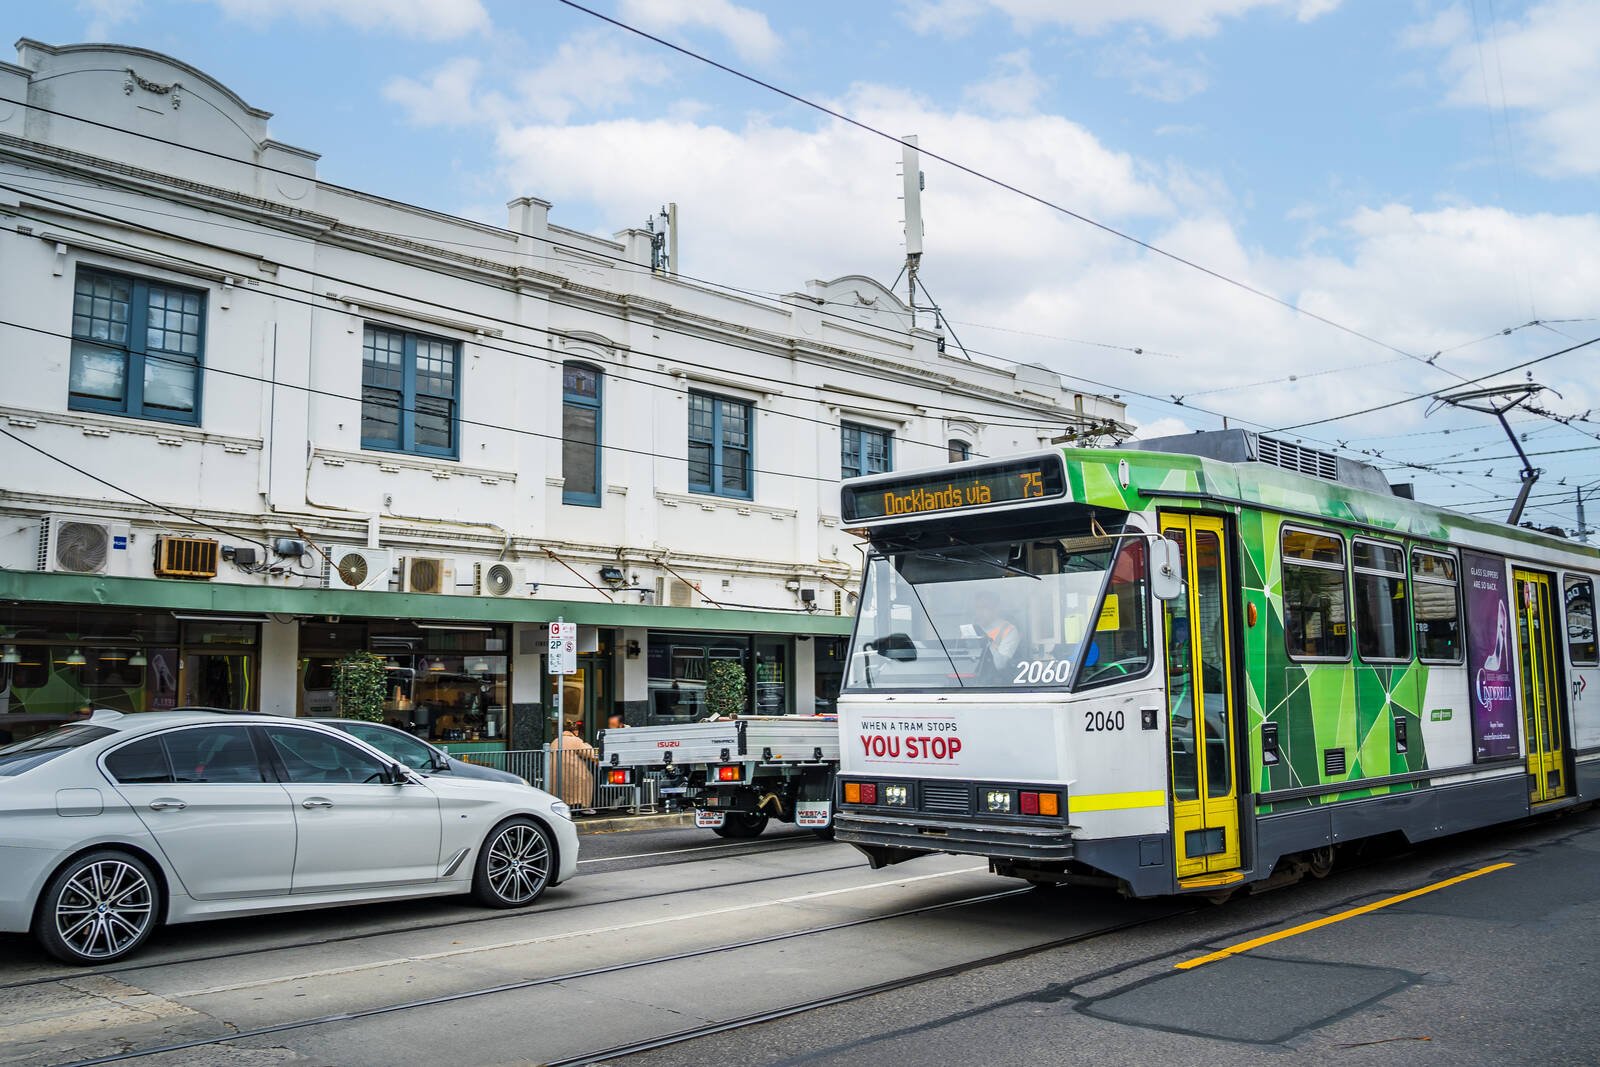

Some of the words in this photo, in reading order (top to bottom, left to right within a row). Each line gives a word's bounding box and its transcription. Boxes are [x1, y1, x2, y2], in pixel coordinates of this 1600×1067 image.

[883, 484, 962, 516] Docklands
[965, 480, 991, 507] via
[1019, 471, 1044, 498] 75
[1471, 567, 1482, 577] GLASS
[1483, 569, 1499, 579] SLIPPERS
[1473, 580, 1481, 589] ARE
[1481, 581, 1487, 590] SO
[550, 640, 562, 650] 2P
[1013, 660, 1071, 684] 2060
[861, 721, 887, 731] WHEN
[890, 722, 896, 730] A
[898, 722, 924, 731] TRAM
[927, 722, 958, 732] STOPS
[1085, 710, 1125, 732] 2060
[860, 735, 900, 758] YOU
[905, 736, 962, 760] STOP
